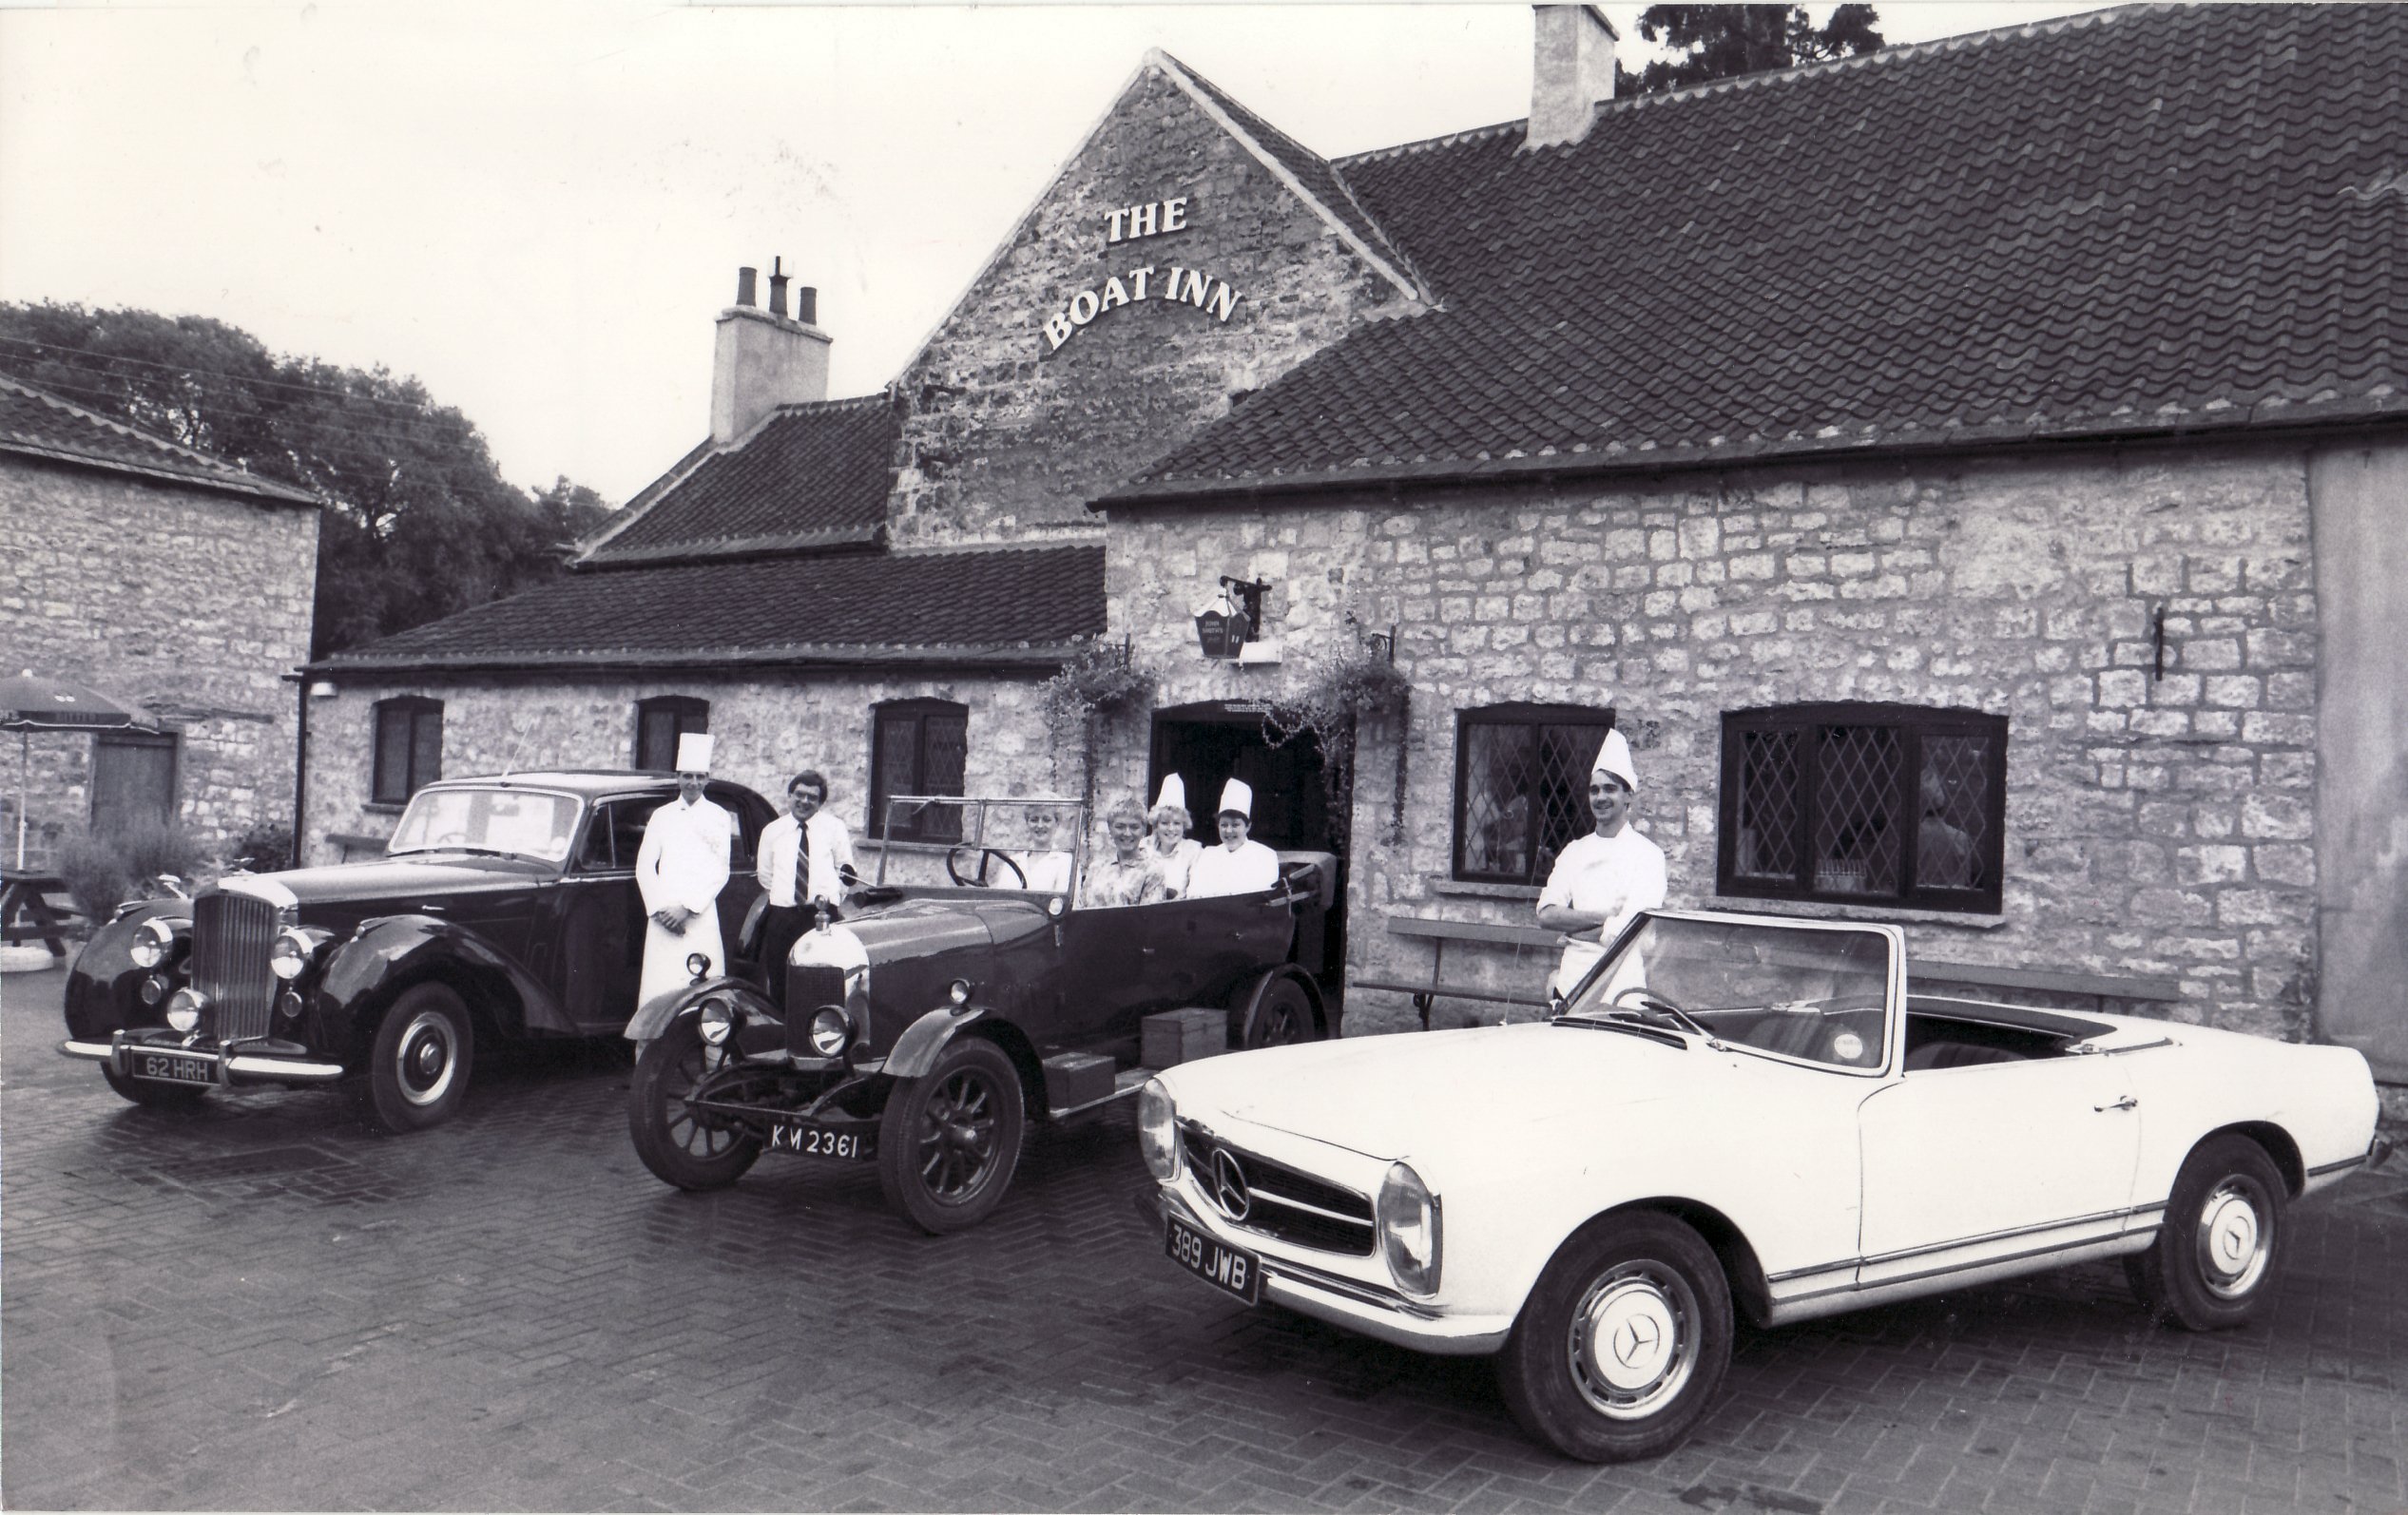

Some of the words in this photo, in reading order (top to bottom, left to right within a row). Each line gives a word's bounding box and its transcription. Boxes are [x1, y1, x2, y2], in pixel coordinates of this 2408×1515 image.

[1104, 197, 1187, 243] THE
[1044, 266, 1155, 351] BOAT
[1165, 267, 1243, 322] INN
[146, 1056, 170, 1077] 62
[173, 1059, 208, 1082] HRH
[1172, 1223, 1203, 1269] 389
[1204, 1246, 1246, 1291] JWB
